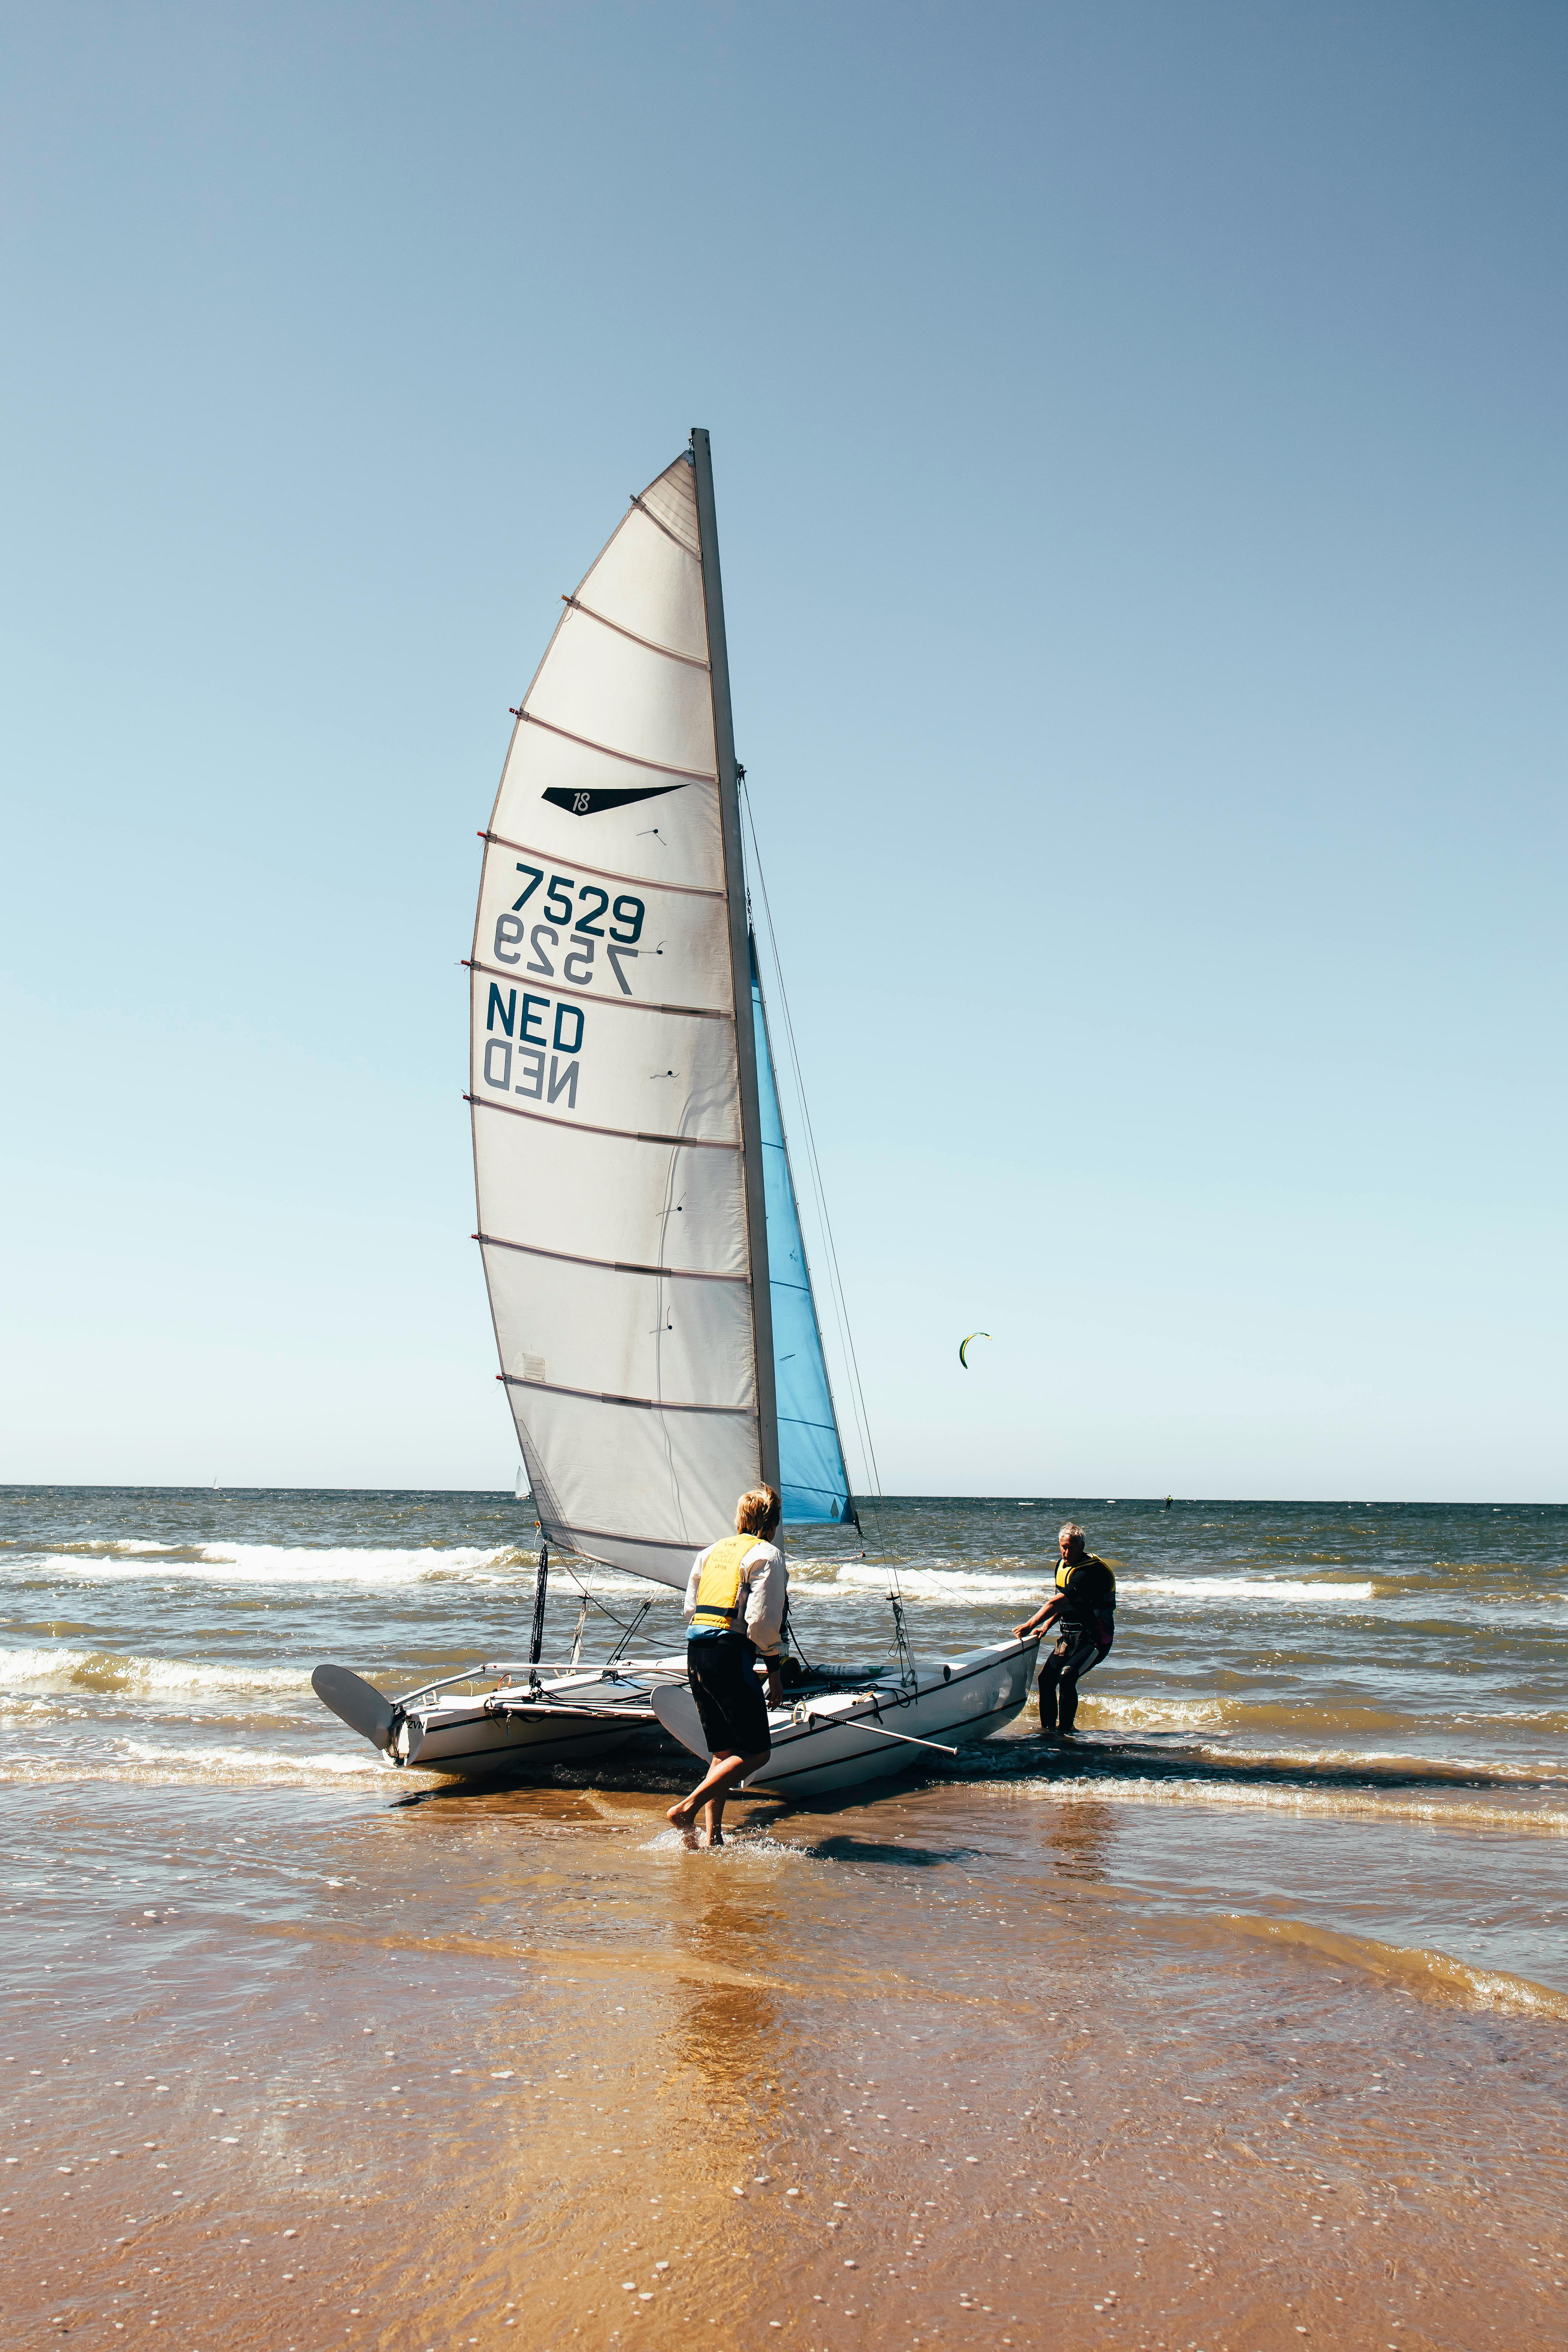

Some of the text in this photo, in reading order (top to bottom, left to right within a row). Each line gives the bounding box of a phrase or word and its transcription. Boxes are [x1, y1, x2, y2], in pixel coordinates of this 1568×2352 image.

[573, 793, 590, 811] 18
[511, 863, 645, 944] 7529
[487, 982, 584, 1054] NED
[712, 1550, 737, 1563] Gill
[407, 1720, 425, 1729] ZVN
